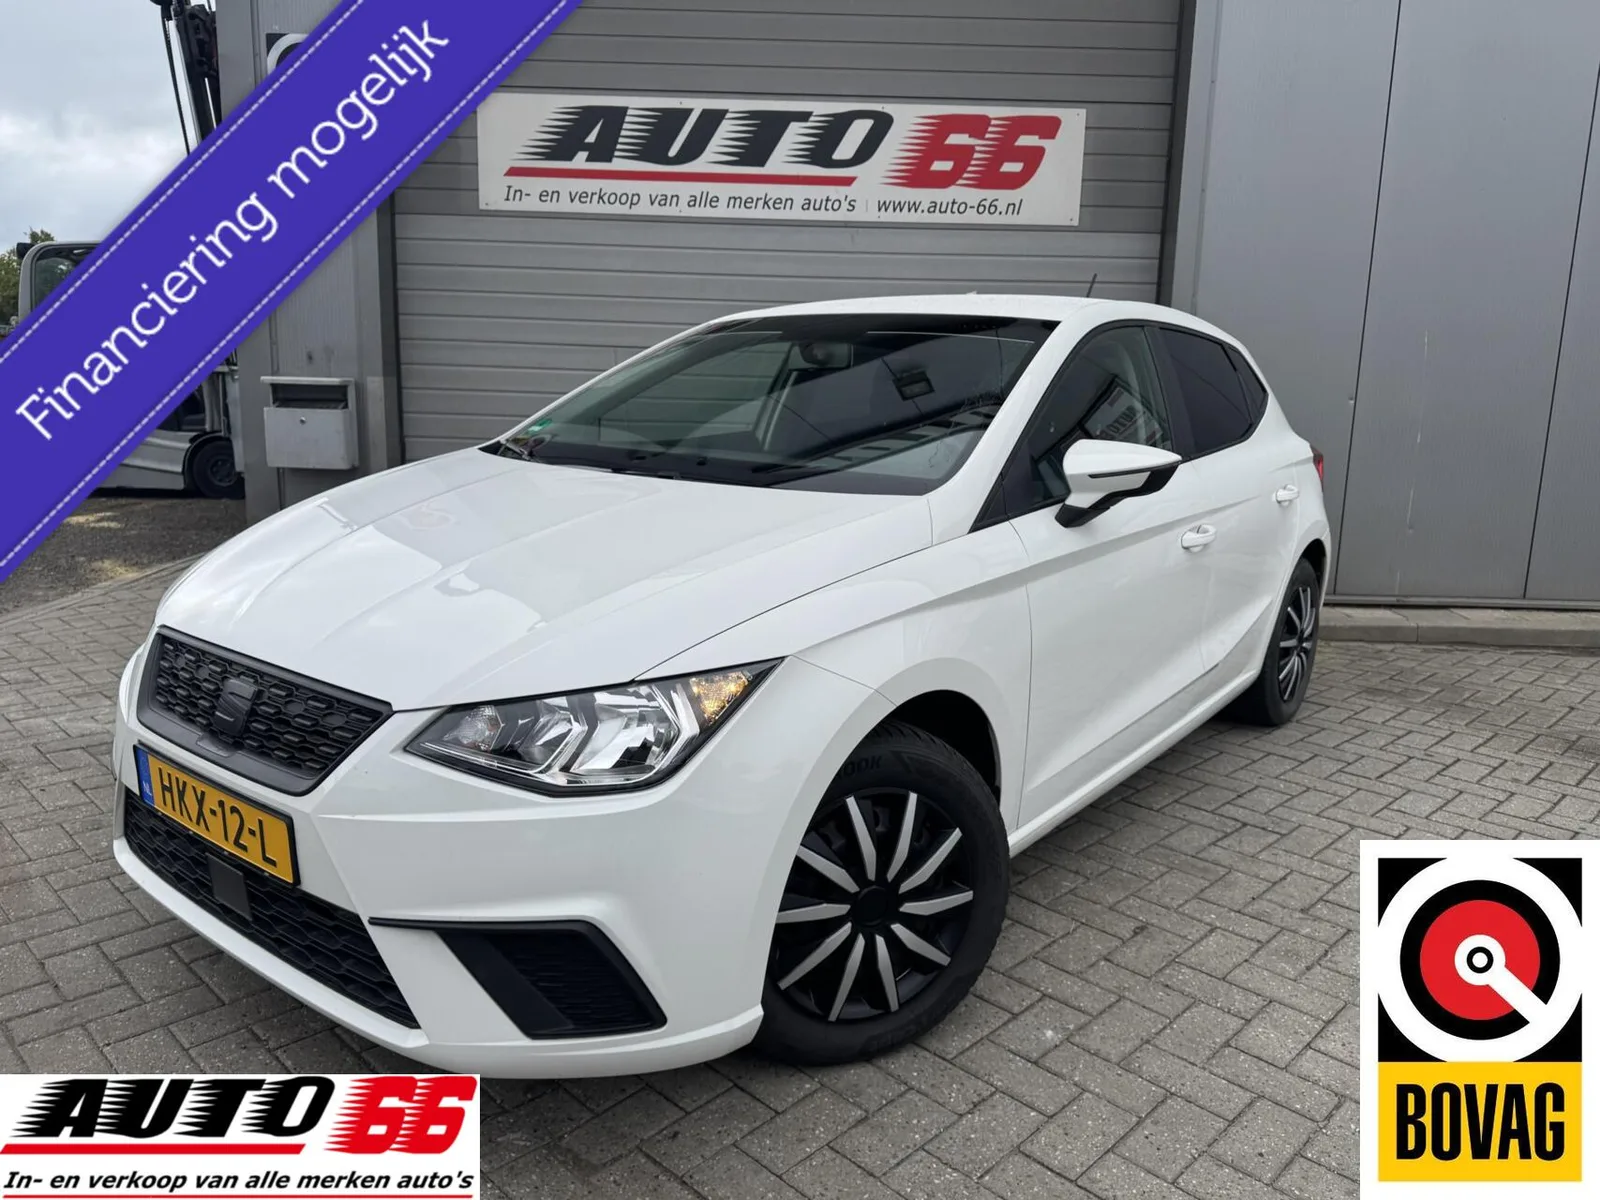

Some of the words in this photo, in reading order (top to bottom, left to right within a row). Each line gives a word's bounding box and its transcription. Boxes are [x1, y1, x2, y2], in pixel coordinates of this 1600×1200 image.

[510, 105, 894, 168] AUTO
[879, 113, 1062, 190] 66
[504, 185, 531, 202] In-
[539, 189, 561, 203] en
[568, 187, 641, 209] verkoop
[649, 193, 680, 207] van
[687, 191, 719, 208] alle
[726, 193, 794, 210] merken
[801, 196, 856, 212] auto's
[877, 198, 1023, 216] www.auto-66.nl
[142, 780, 152, 796] NL
[158, 767, 278, 869] HKX-12-L
